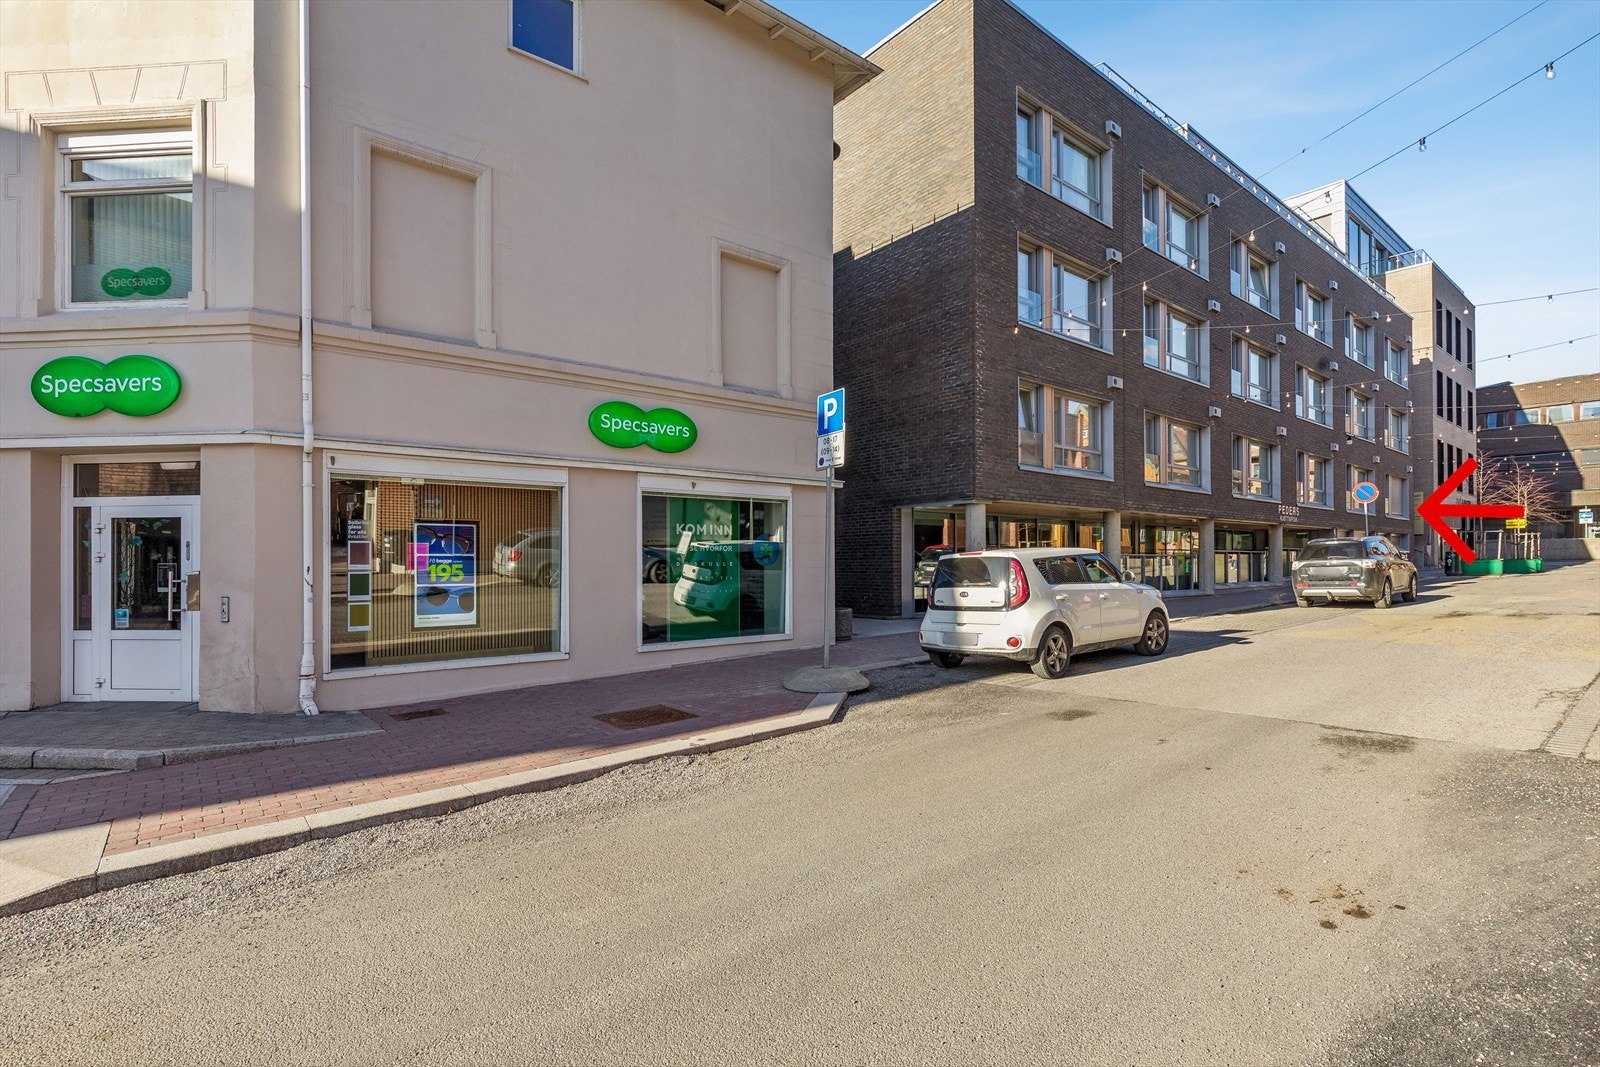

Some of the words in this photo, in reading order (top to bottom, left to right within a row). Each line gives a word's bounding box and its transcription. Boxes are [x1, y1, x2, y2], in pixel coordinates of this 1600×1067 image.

[107, 276, 165, 289] Specsavers
[41, 375, 162, 398] Specsavers
[824, 397, 837, 430] P
[600, 413, 690, 438] Specsavers
[823, 435, 838, 445] 08-17
[821, 445, 840, 456] (09-14)
[1278, 504, 1299, 516] PEDERS
[709, 524, 733, 536] INN
[427, 563, 465, 583] 195
